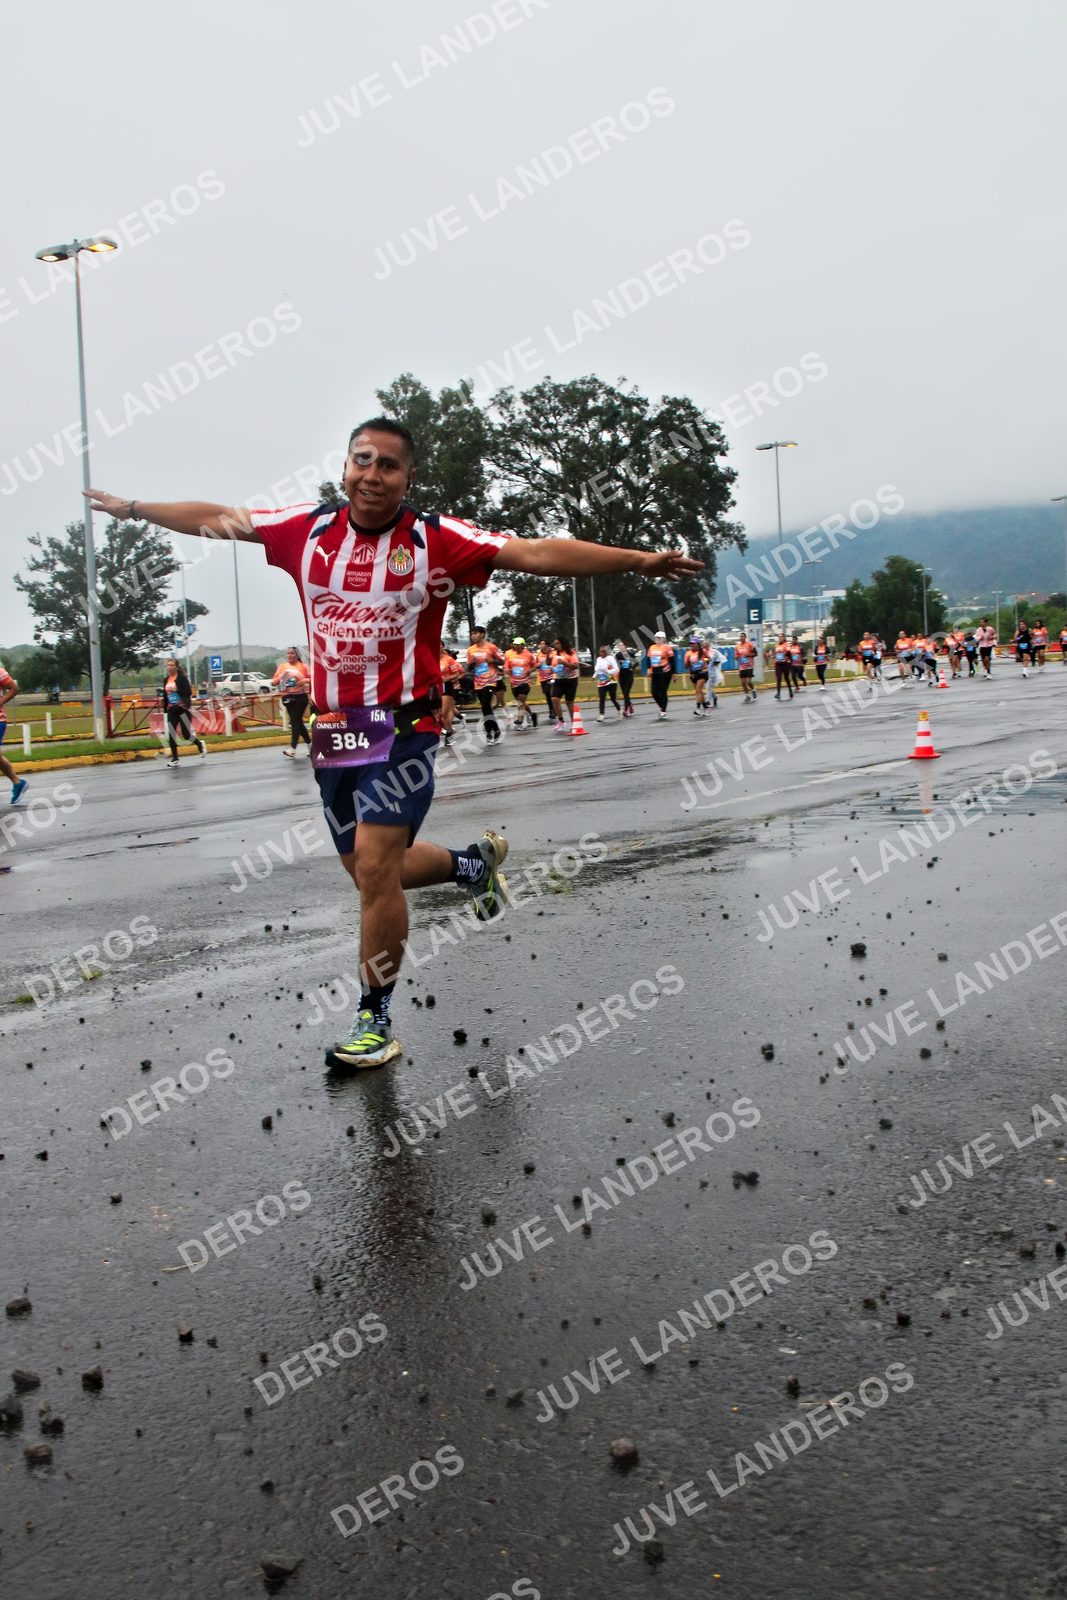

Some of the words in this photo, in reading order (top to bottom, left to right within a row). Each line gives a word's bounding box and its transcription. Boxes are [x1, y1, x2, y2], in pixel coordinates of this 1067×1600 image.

[351, 543, 376, 565] MG
[750, 609, 759, 621] E
[342, 654, 386, 662] mercado
[343, 663, 367, 671] pago
[370, 709, 386, 722] 15K
[331, 732, 370, 750] 384
